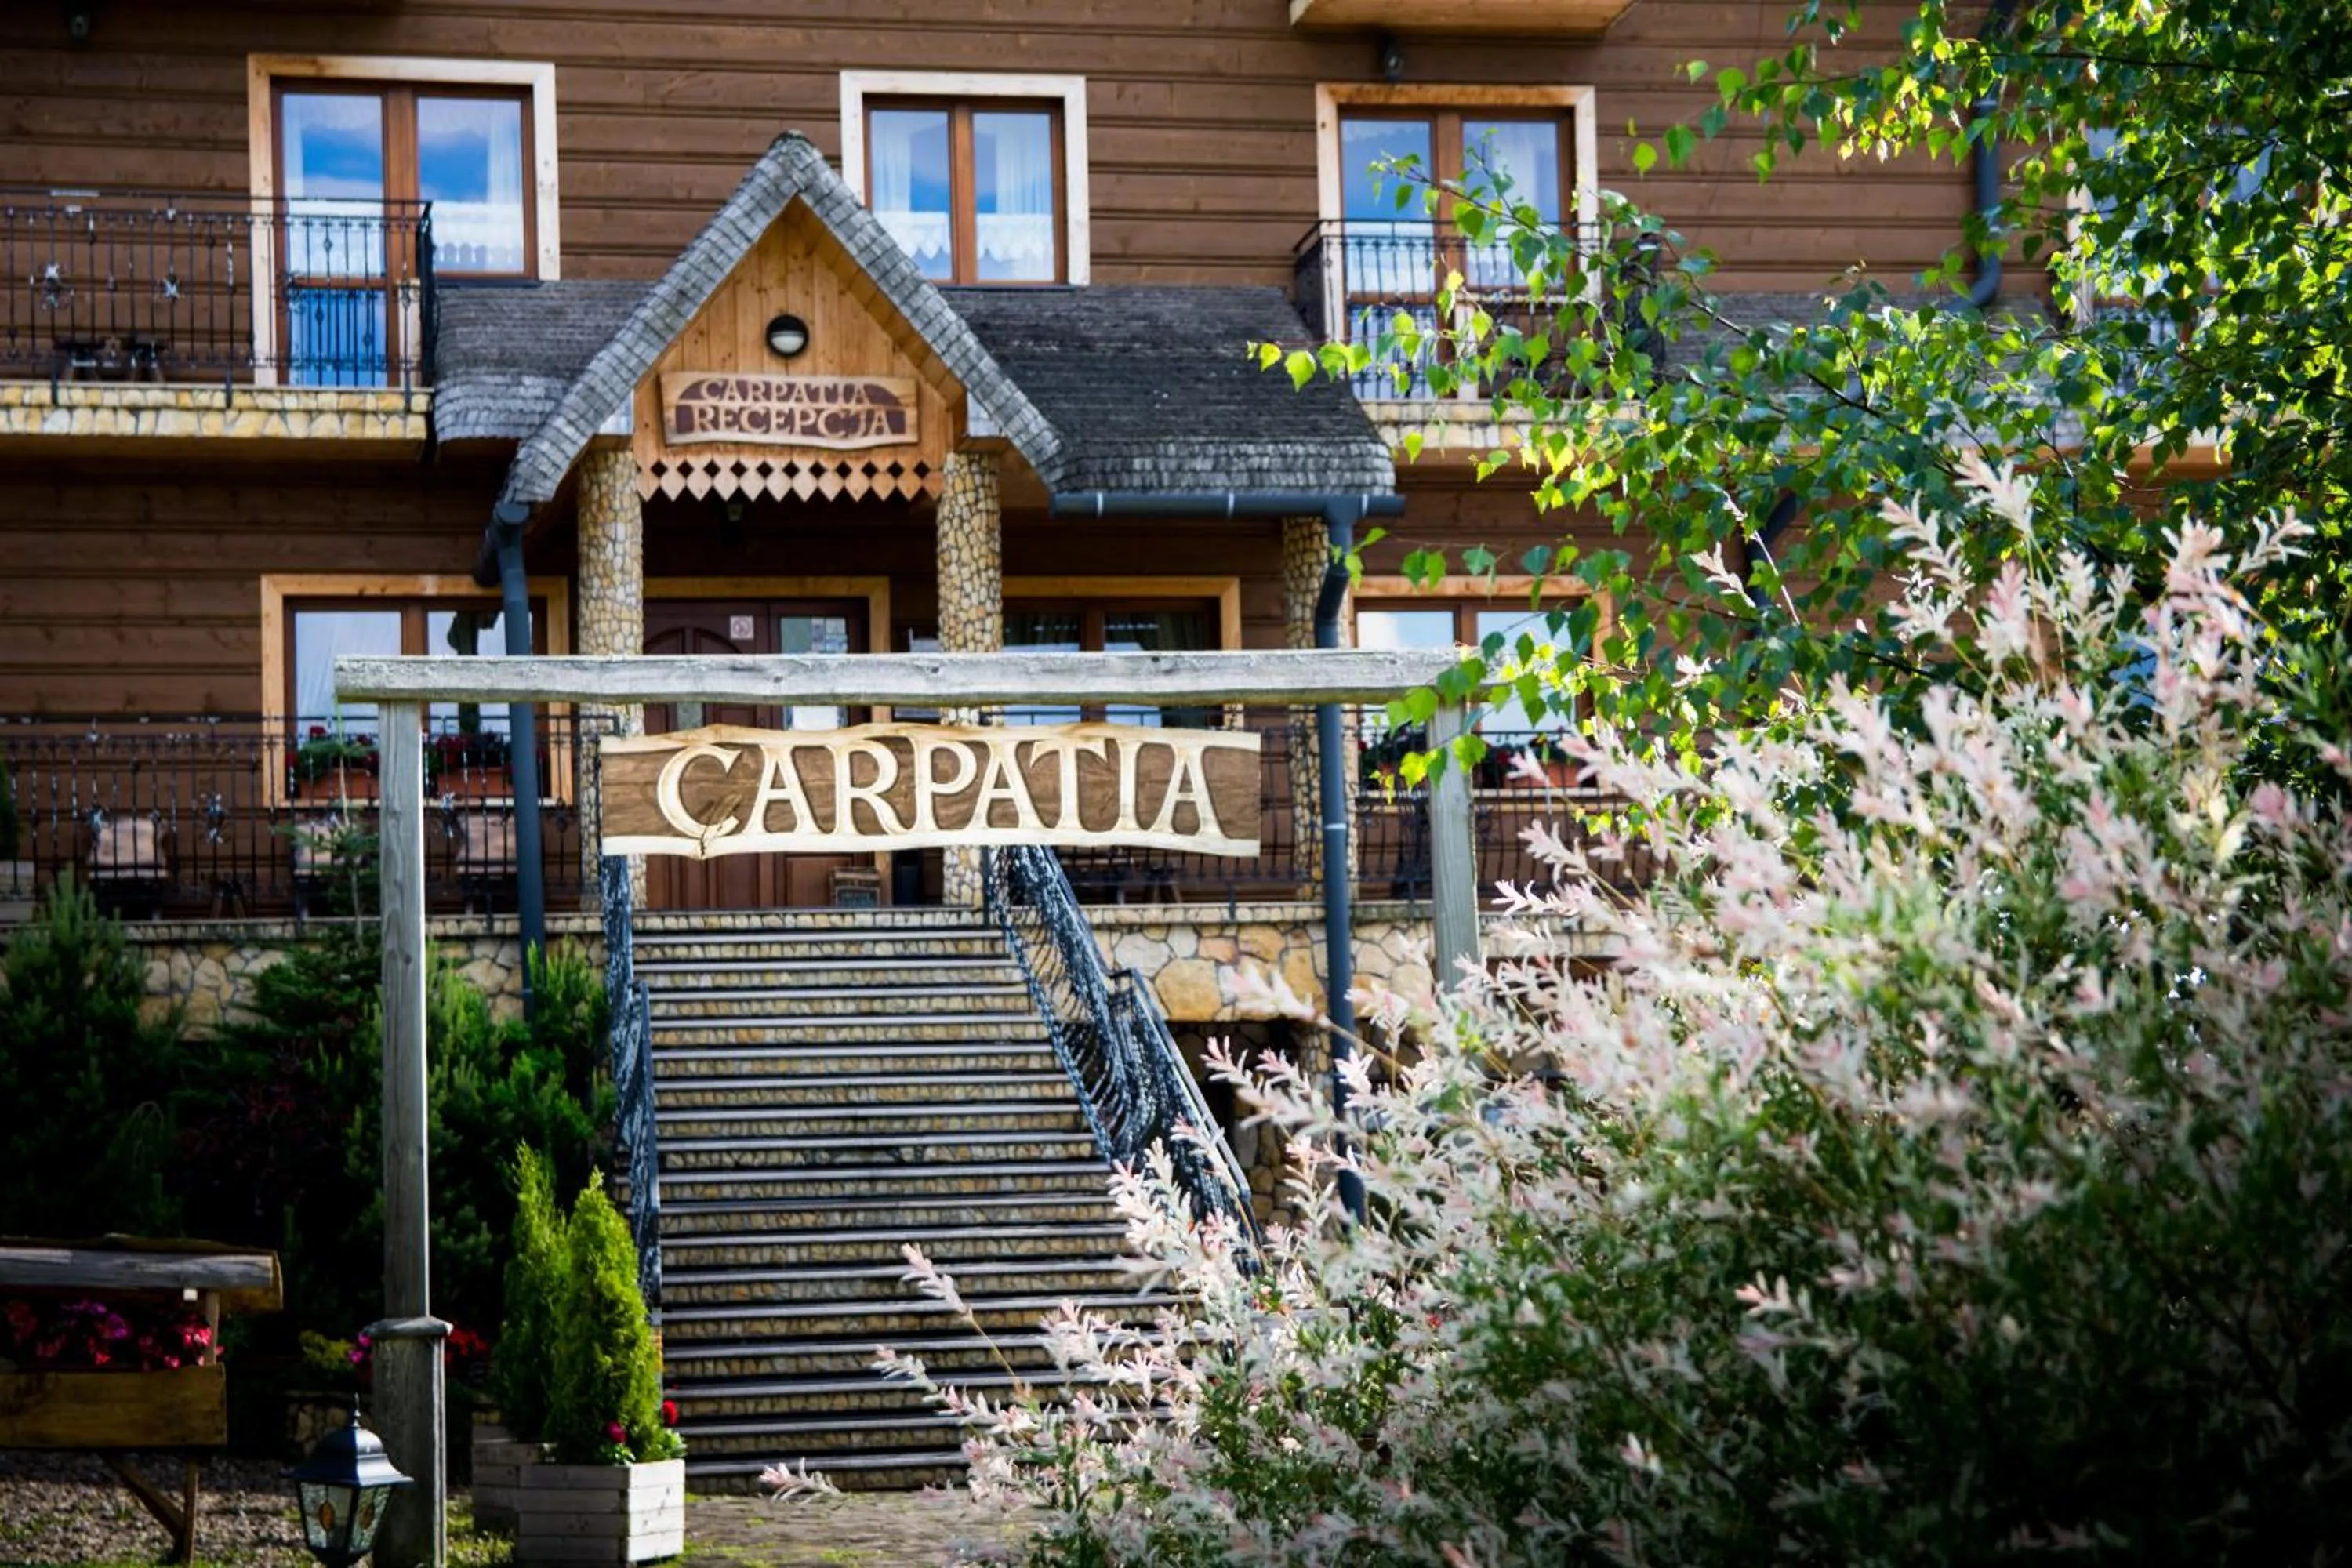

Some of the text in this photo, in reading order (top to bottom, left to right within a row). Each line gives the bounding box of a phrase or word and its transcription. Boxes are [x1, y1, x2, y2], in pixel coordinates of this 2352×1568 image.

[700, 378, 871, 404] CARPATIA
[692, 404, 892, 438] RECEPCJA
[656, 737, 1223, 839] CARPATIA
